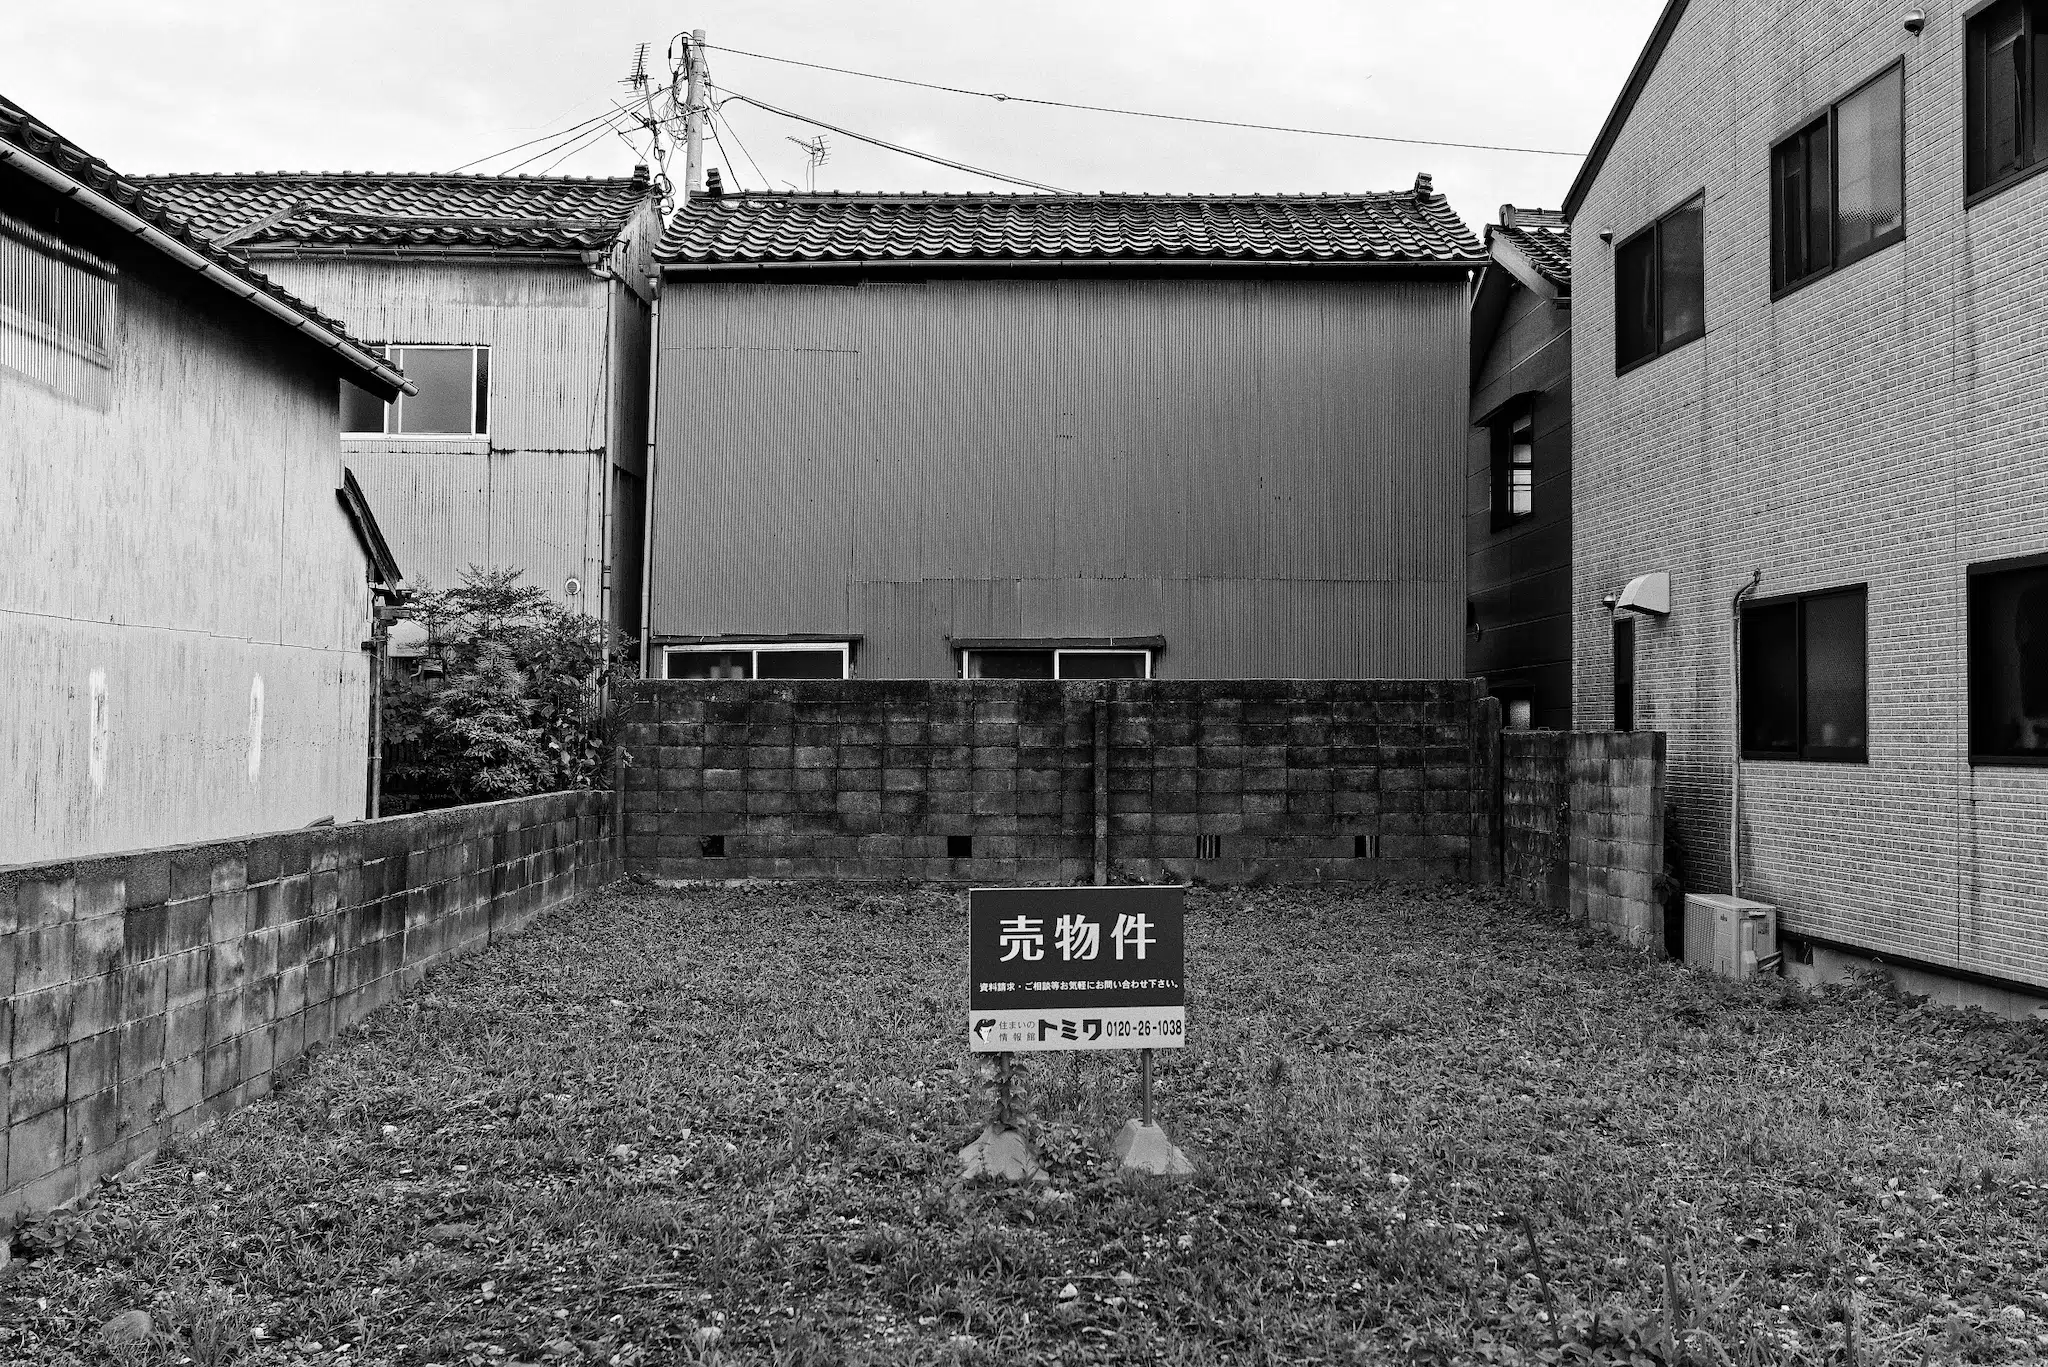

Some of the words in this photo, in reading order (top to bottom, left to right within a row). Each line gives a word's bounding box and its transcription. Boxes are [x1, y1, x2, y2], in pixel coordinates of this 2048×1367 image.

[999, 913, 1157, 962] 売物件
[979, 979, 1179, 993] 資料請求・ご相談等お気軽にお問い合わせ下さい。
[998, 1020, 1035, 1030] 住まいの
[1038, 1018, 1102, 1041] トミワ
[1106, 1019, 1182, 1037] 0120-26-1038
[998, 1032, 1036, 1042] 情報館
